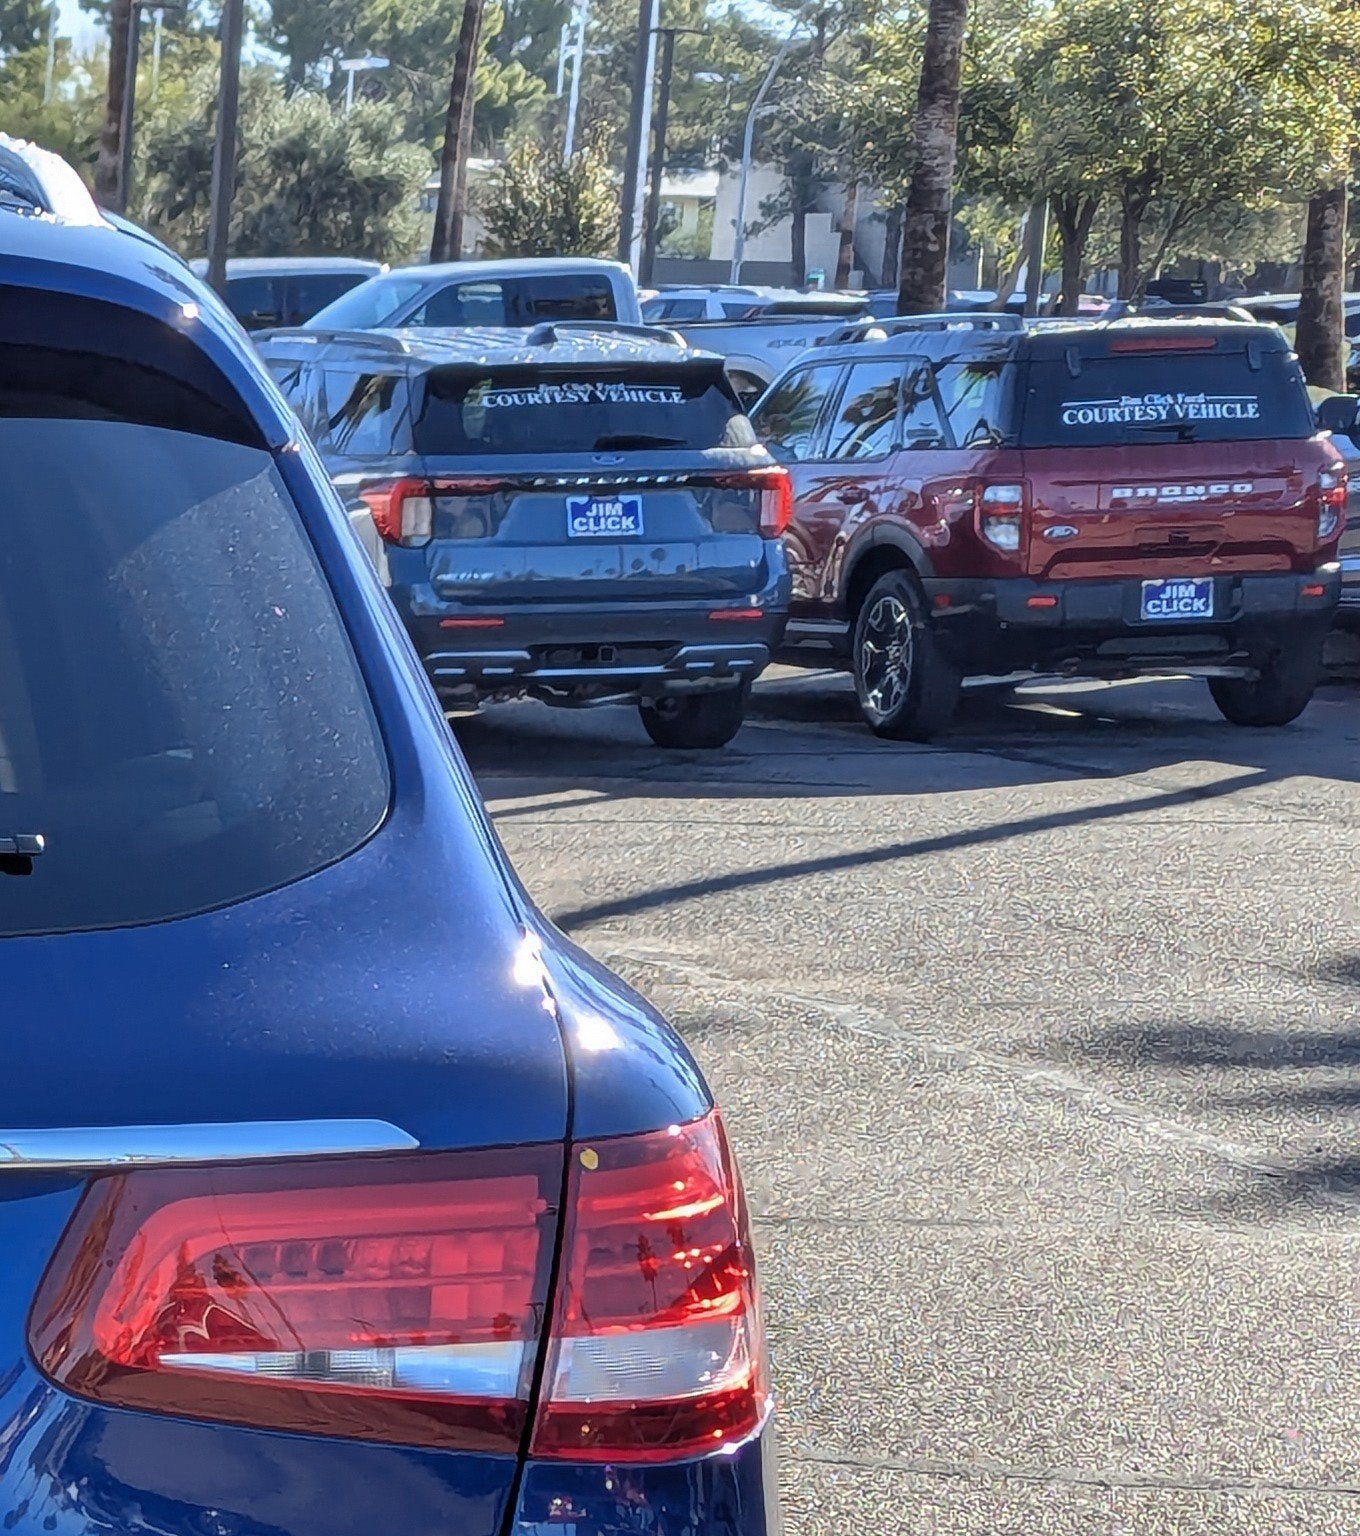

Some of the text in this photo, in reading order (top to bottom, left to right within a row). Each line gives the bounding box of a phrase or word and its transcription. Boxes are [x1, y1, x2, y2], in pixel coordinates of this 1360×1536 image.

[482, 389, 686, 408] COURTESY VEHICLE
[1062, 402, 1261, 425] COURTESY VEHICLE
[1112, 483, 1254, 498] BRONCO
[586, 502, 623, 517] JIM
[573, 515, 635, 531] CLICK
[1159, 584, 1196, 599] JIM
[1146, 598, 1206, 613] CLICK
